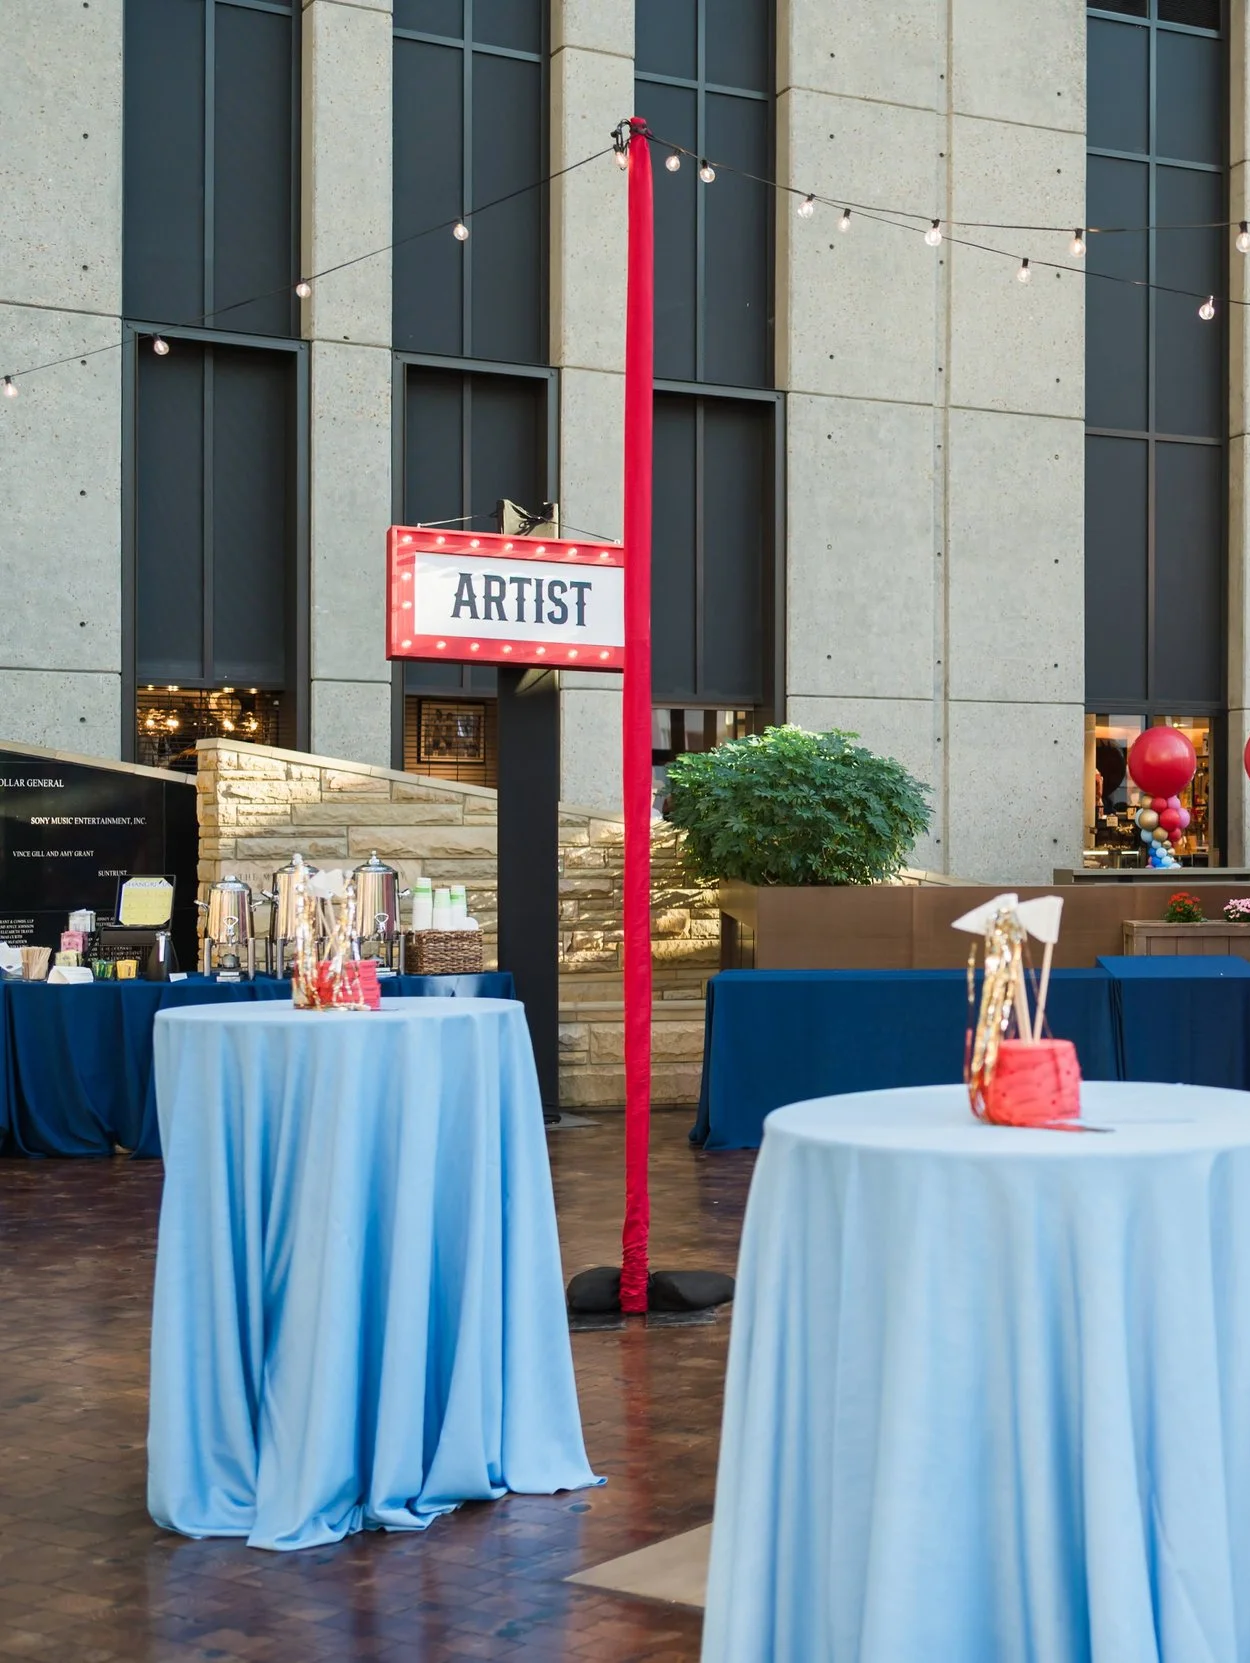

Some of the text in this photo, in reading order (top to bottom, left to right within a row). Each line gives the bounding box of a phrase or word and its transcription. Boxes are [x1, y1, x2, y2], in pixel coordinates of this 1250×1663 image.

[450, 572, 592, 627] ARTIST
[26, 778, 65, 788] GENERAL
[30, 817, 50, 825] SONY
[51, 817, 73, 825] MUSIC
[74, 817, 132, 826] ENTERTAINMENT,
